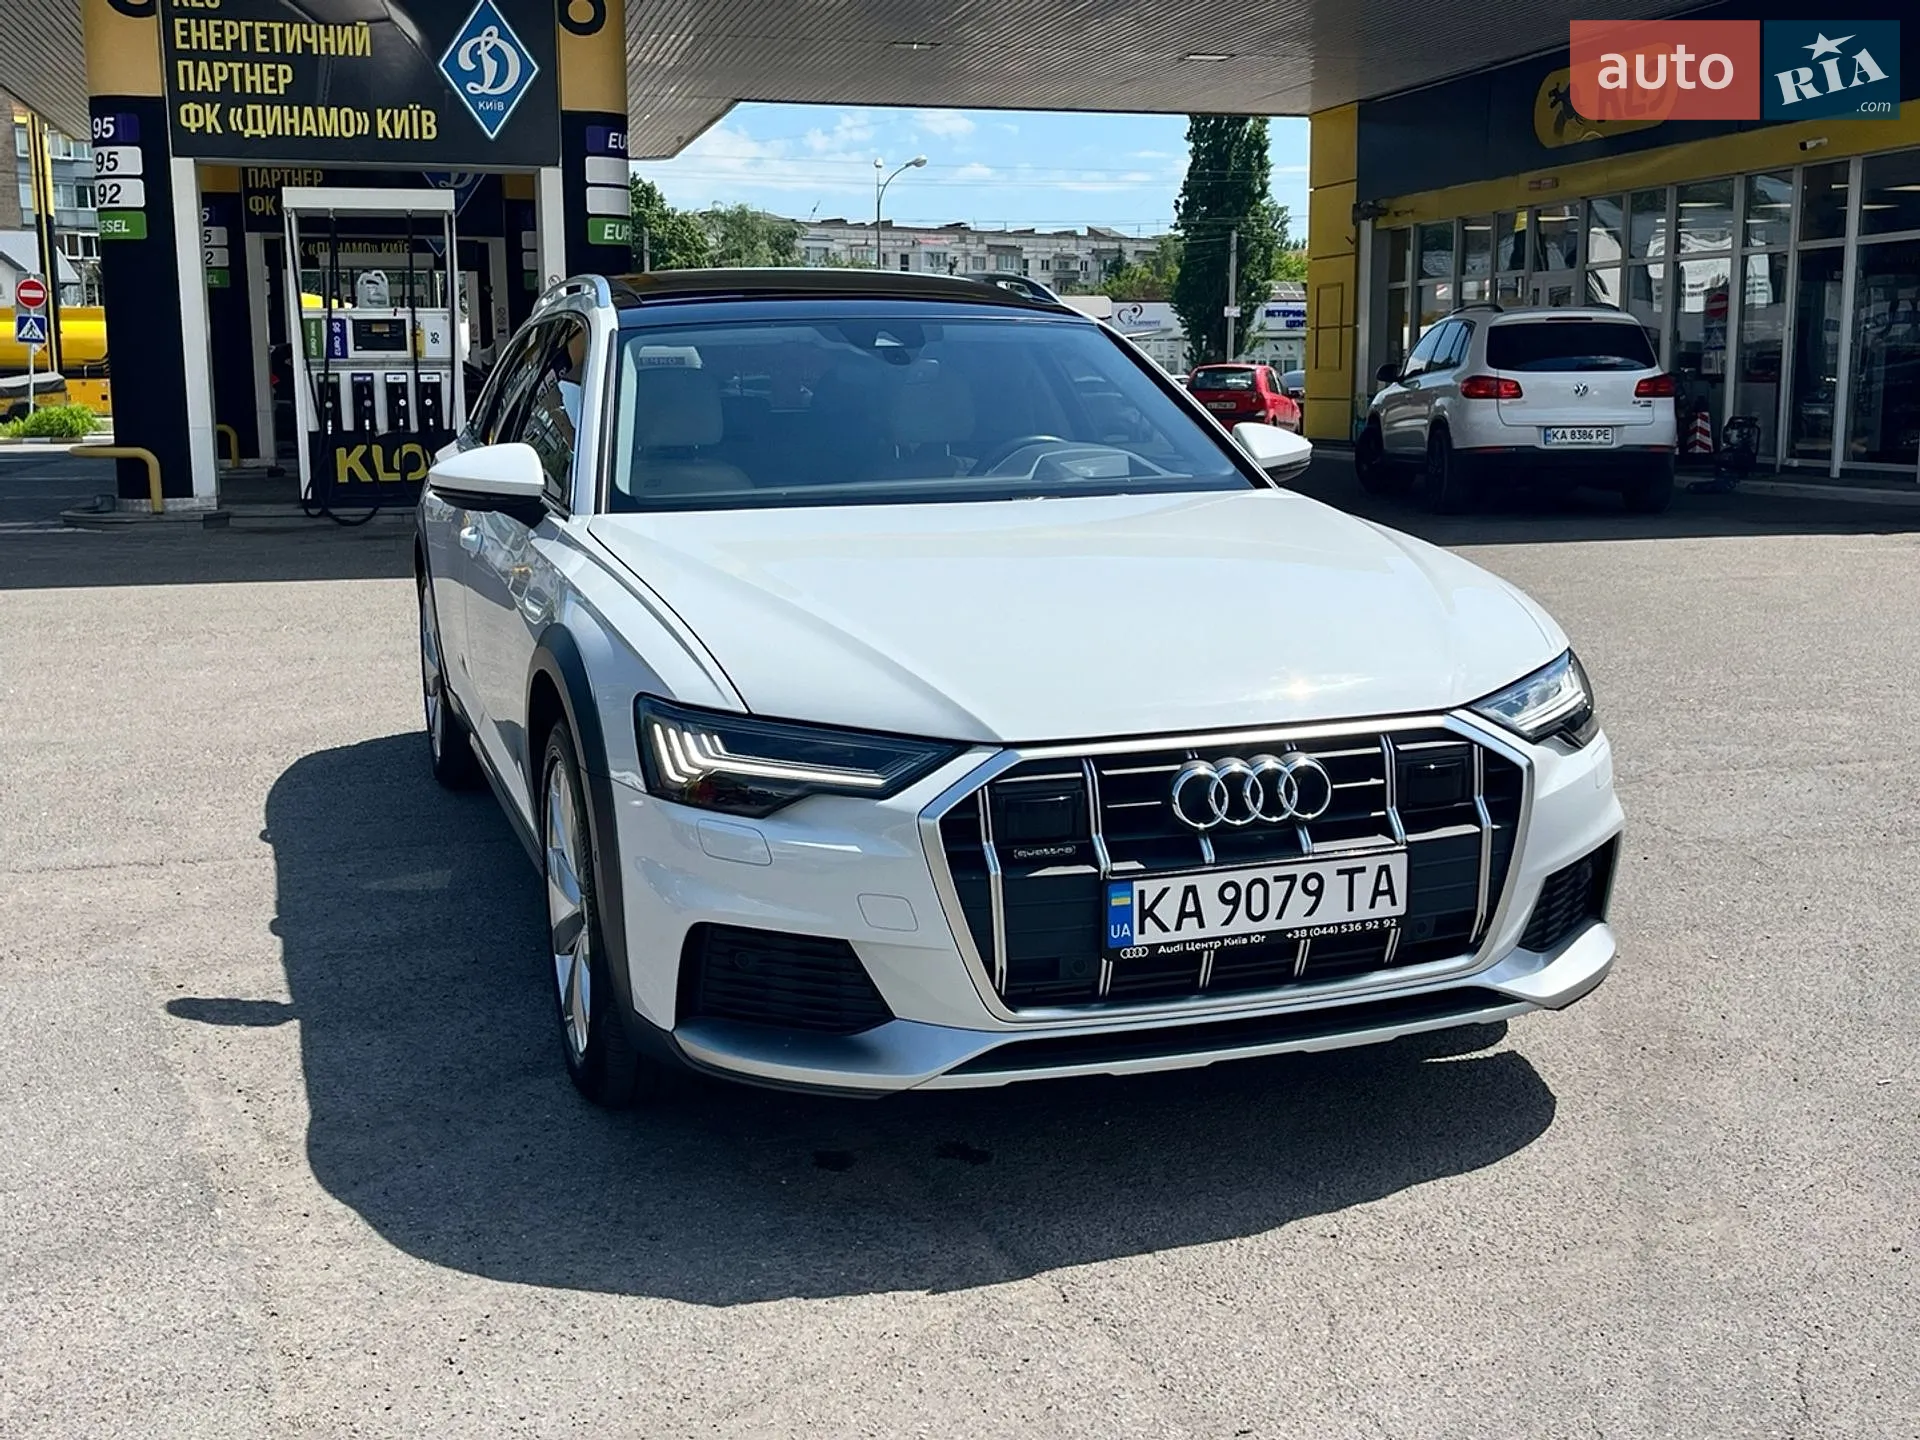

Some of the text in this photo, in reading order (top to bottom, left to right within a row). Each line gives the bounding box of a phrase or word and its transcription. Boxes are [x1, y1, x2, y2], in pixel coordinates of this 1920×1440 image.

[174, 18, 372, 57] ЕНЕРГЕТИЧНИЙ
[177, 60, 294, 95] ПАРТНЕР
[478, 99, 504, 111] КИЇВ
[93, 117, 115, 139] 95
[179, 102, 438, 140] ФК «ДИНАМО» КИЇВ
[96, 151, 119, 173] 95
[247, 167, 324, 188] ПАРТНЕР
[98, 183, 122, 205] 92
[249, 195, 277, 216] ФК
[1551, 429, 1610, 440] KA 8386 PE
[1138, 864, 1397, 935] KA 9079 TA
[1111, 923, 1131, 938] UA
[1286, 918, 1396, 939] +38 (044) 536 92 92
[1157, 942, 1183, 954] Audi
[1250, 934, 1266, 943] Юг
